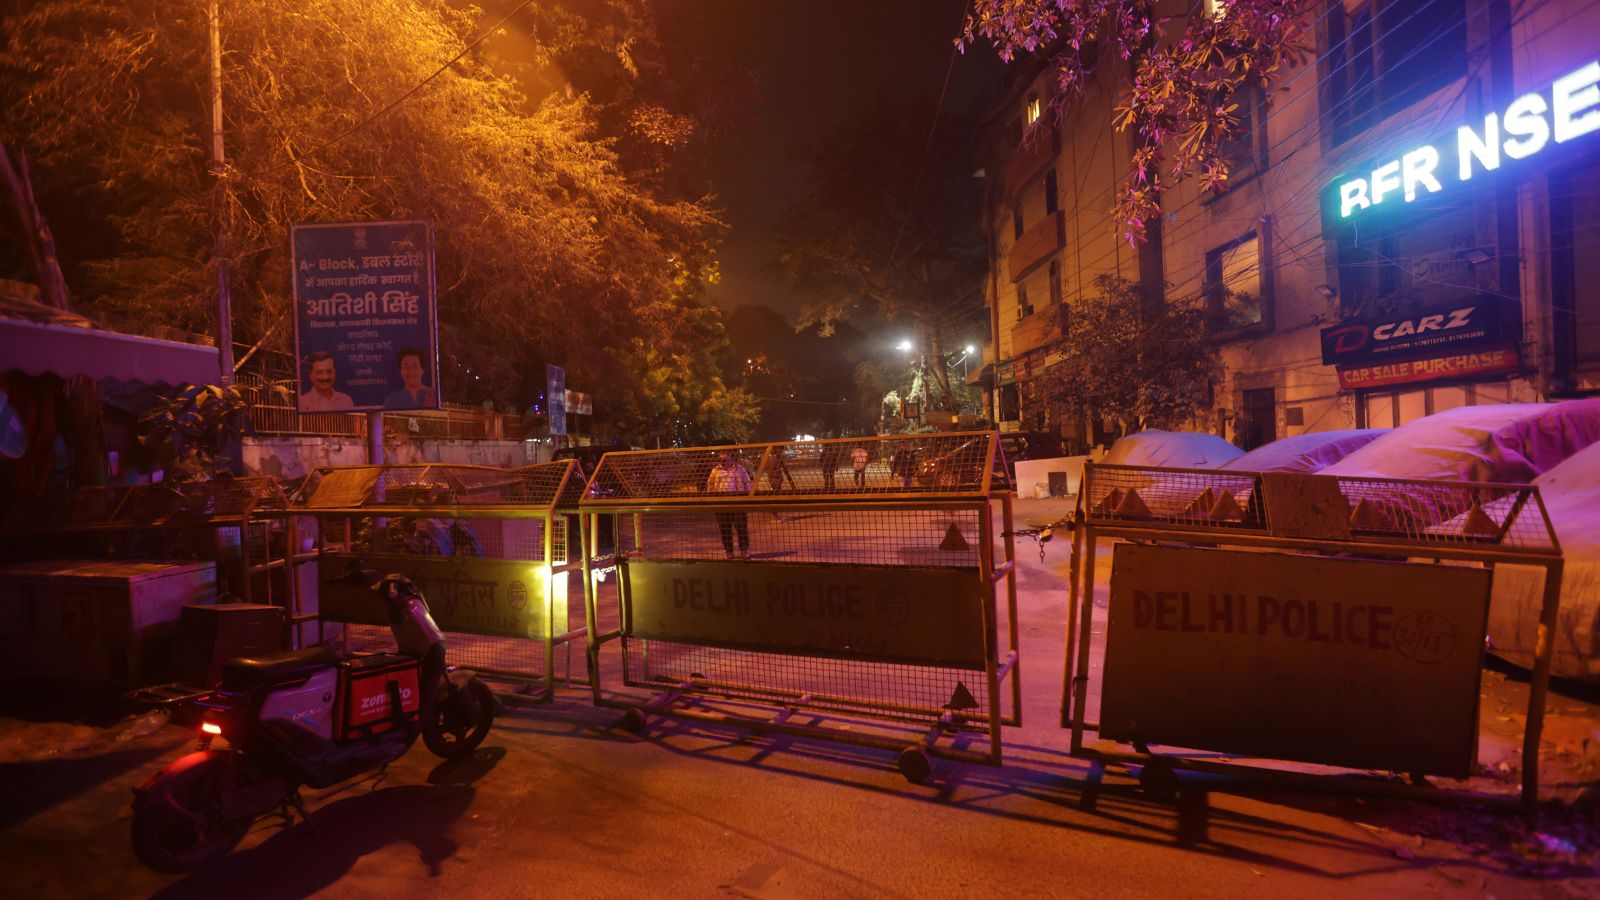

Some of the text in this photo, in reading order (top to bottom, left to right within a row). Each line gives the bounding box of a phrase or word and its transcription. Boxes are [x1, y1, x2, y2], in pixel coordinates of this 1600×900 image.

[1340, 145, 1442, 218] RFR
[319, 258, 360, 270] Block,
[361, 256, 391, 269] डबल
[316, 277, 347, 287] आपका
[380, 275, 411, 286] स्वागत
[306, 290, 420, 317] आतिशी सिंह
[1373, 307, 1476, 341] CARZ
[1343, 351, 1505, 383] CAR SALE PURCHASE
[437, 570, 498, 616] पुलिस
[672, 578, 752, 616] DELHI
[765, 581, 865, 621] POLICE
[1132, 590, 1393, 650] DELHI POLICE
